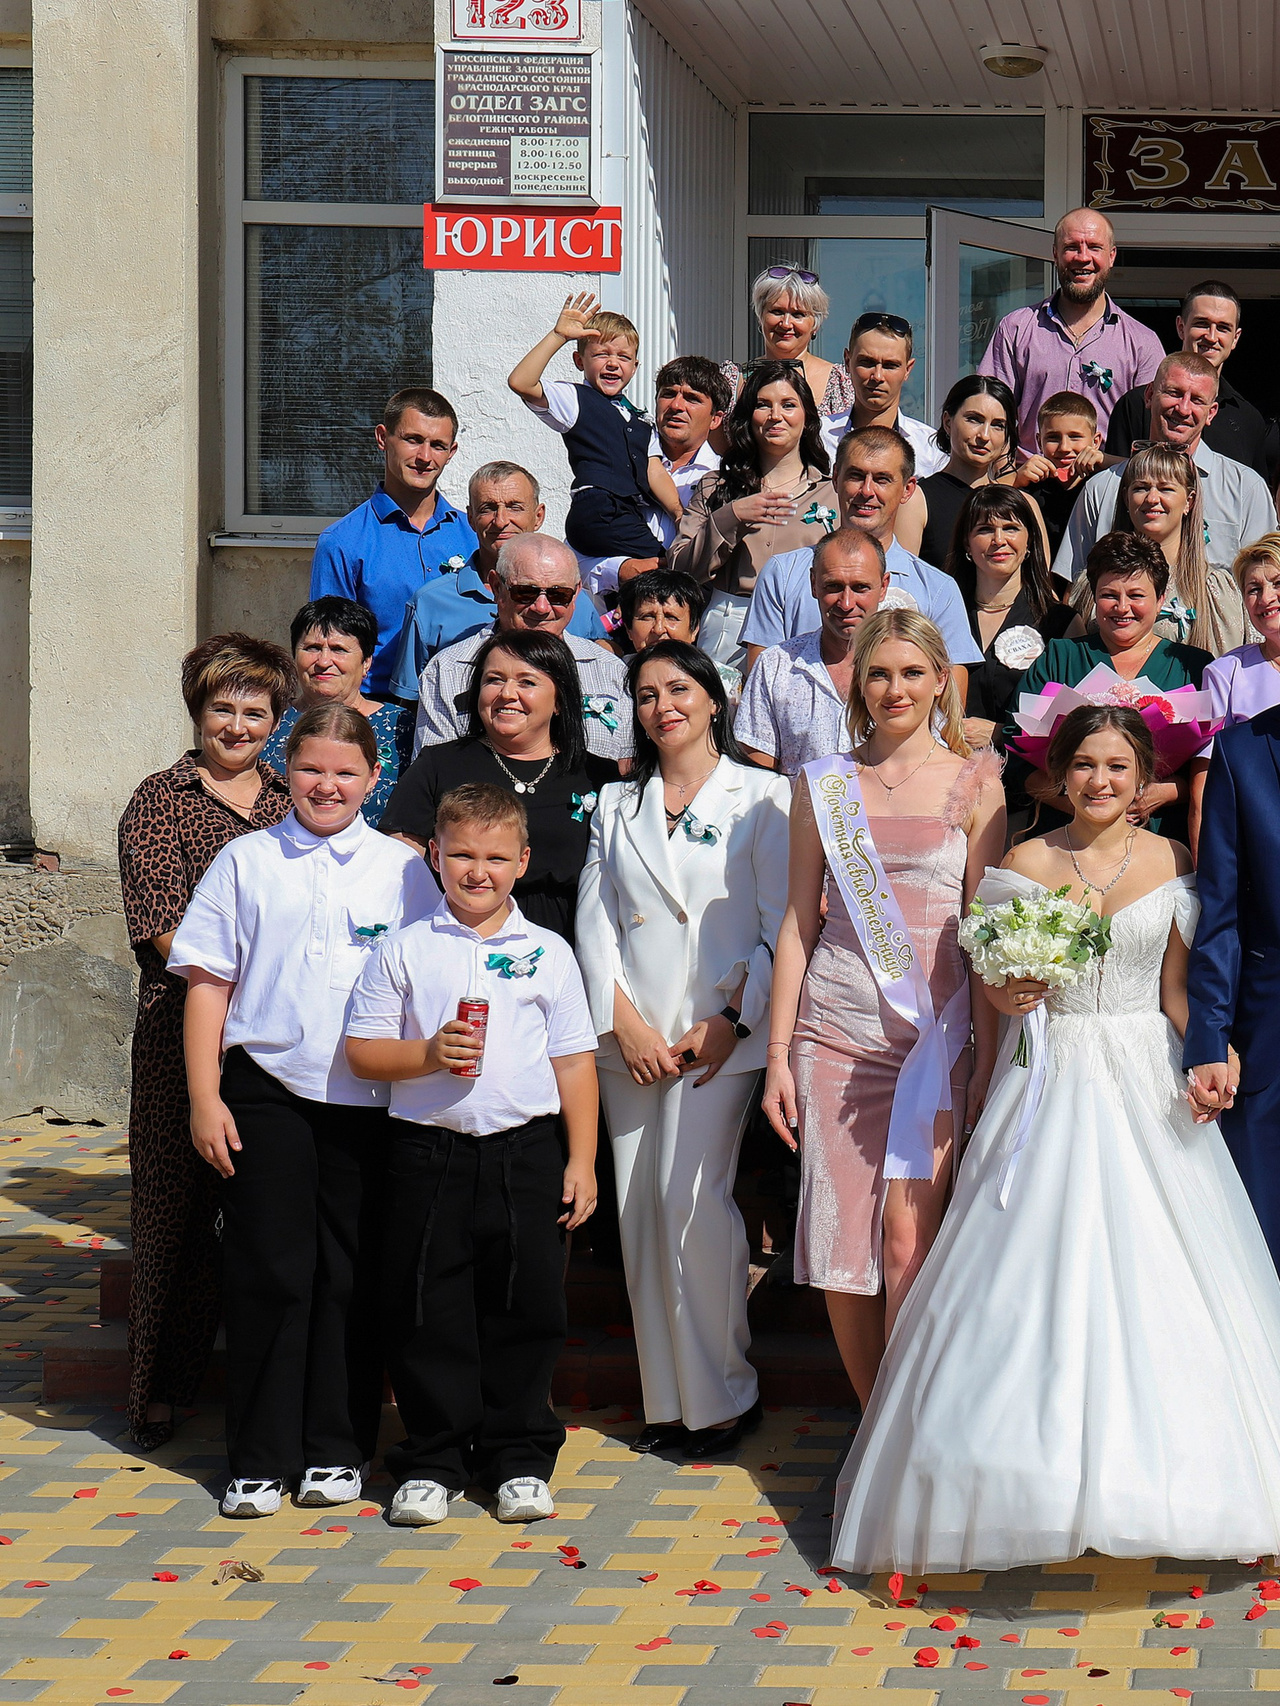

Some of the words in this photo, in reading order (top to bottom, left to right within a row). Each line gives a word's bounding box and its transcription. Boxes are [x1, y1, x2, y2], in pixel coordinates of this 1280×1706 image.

[467, 0, 569, 30] 123
[454, 55, 520, 64] РОССИЙСКАЯ
[523, 56, 584, 65] ФЕДЕРАЦИЯ
[447, 65, 512, 73] УПРАВЛЕНИЕ
[515, 65, 555, 74] ЗАПИСИ
[559, 66, 591, 75] АКТОВ
[447, 74, 528, 83] ГРАЖДАНСКОГО
[531, 75, 591, 84] СОСТОЯНИЯ
[457, 83, 550, 93] КРАСНОДАРСКОГО
[553, 84, 580, 93] КРАЯ
[450, 94, 523, 113] ОТДЕЛ
[529, 95, 587, 112] ЗАГС
[449, 114, 540, 124] БЕЛОГЛИНСКОГО
[544, 114, 589, 125] РАЙОНА
[479, 126, 515, 134] РЕЖИМ
[518, 126, 558, 134] РАБОТЫ
[448, 138, 510, 147] ежедневно
[520, 138, 579, 147] 8.00-17.00
[448, 149, 496, 159] пятница
[520, 150, 579, 159] 8.00-16.00
[448, 161, 498, 171] перерыв
[517, 161, 582, 170] 12.00-12.50
[448, 176, 504, 186] выходной
[514, 174, 585, 182] воскресенье
[514, 184, 587, 192] понедельник
[435, 216, 622, 259] ЮРИСТ
[845, 851, 905, 982] свидетельница
